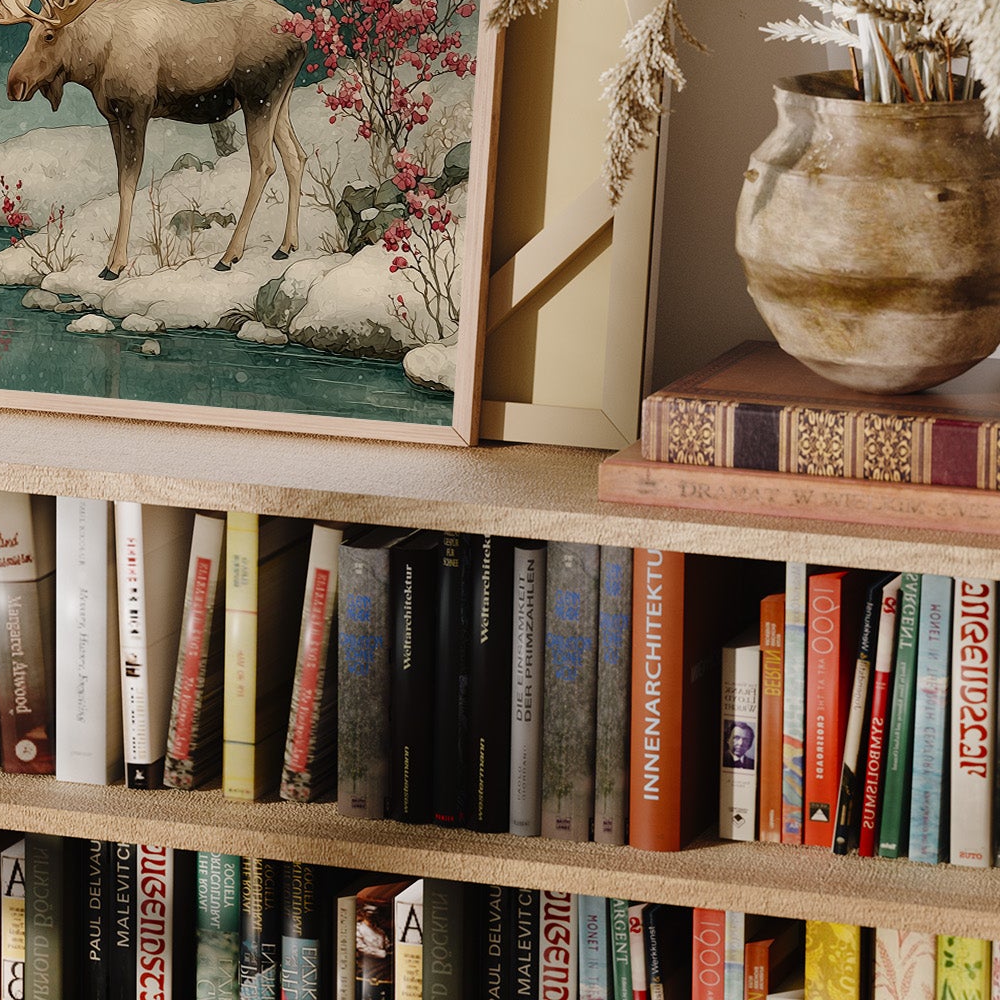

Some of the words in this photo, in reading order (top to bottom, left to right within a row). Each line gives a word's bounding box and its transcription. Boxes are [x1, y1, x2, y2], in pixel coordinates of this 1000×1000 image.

[403, 563, 413, 670] Weltarchitektur
[480, 534, 492, 644] Weltarchitek
[525, 559, 536, 679] PRIMZAHLEN
[6, 595, 24, 658] Margaret
[517, 576, 526, 688] EINSAMKEIT
[11, 661, 32, 714] Atwood
[524, 685, 533, 722] DER
[89, 841, 101, 927] DELVAU
[89, 931, 101, 962] PAUL
[488, 885, 502, 966] DELVAU
[587, 914, 598, 951] MONET
[612, 899, 628, 965] ARGENT
[629, 917, 642, 934] 2
[650, 926, 660, 975] Werkkunst
[693, 921, 721, 987] 1900
